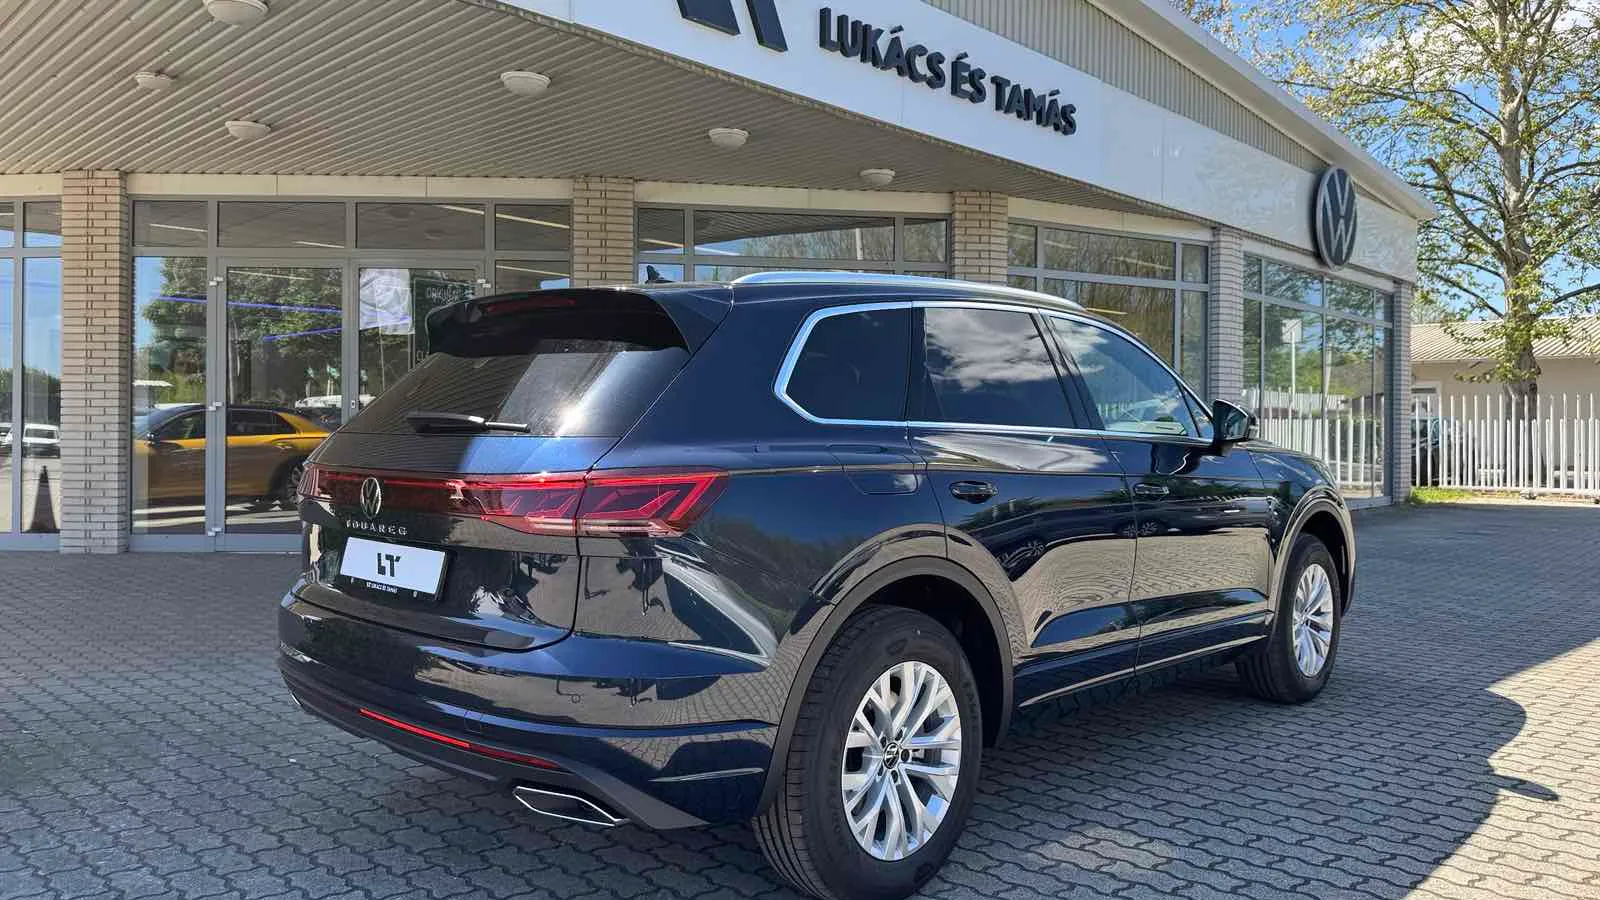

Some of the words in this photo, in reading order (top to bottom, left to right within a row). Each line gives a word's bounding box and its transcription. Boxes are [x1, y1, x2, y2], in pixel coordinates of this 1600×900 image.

[818, 7, 946, 89] LUKÁCS
[951, 52, 986, 103] ÉS
[991, 75, 1077, 136] TAMÁS
[345, 520, 408, 536] TOUAREG
[377, 552, 401, 577] LT
